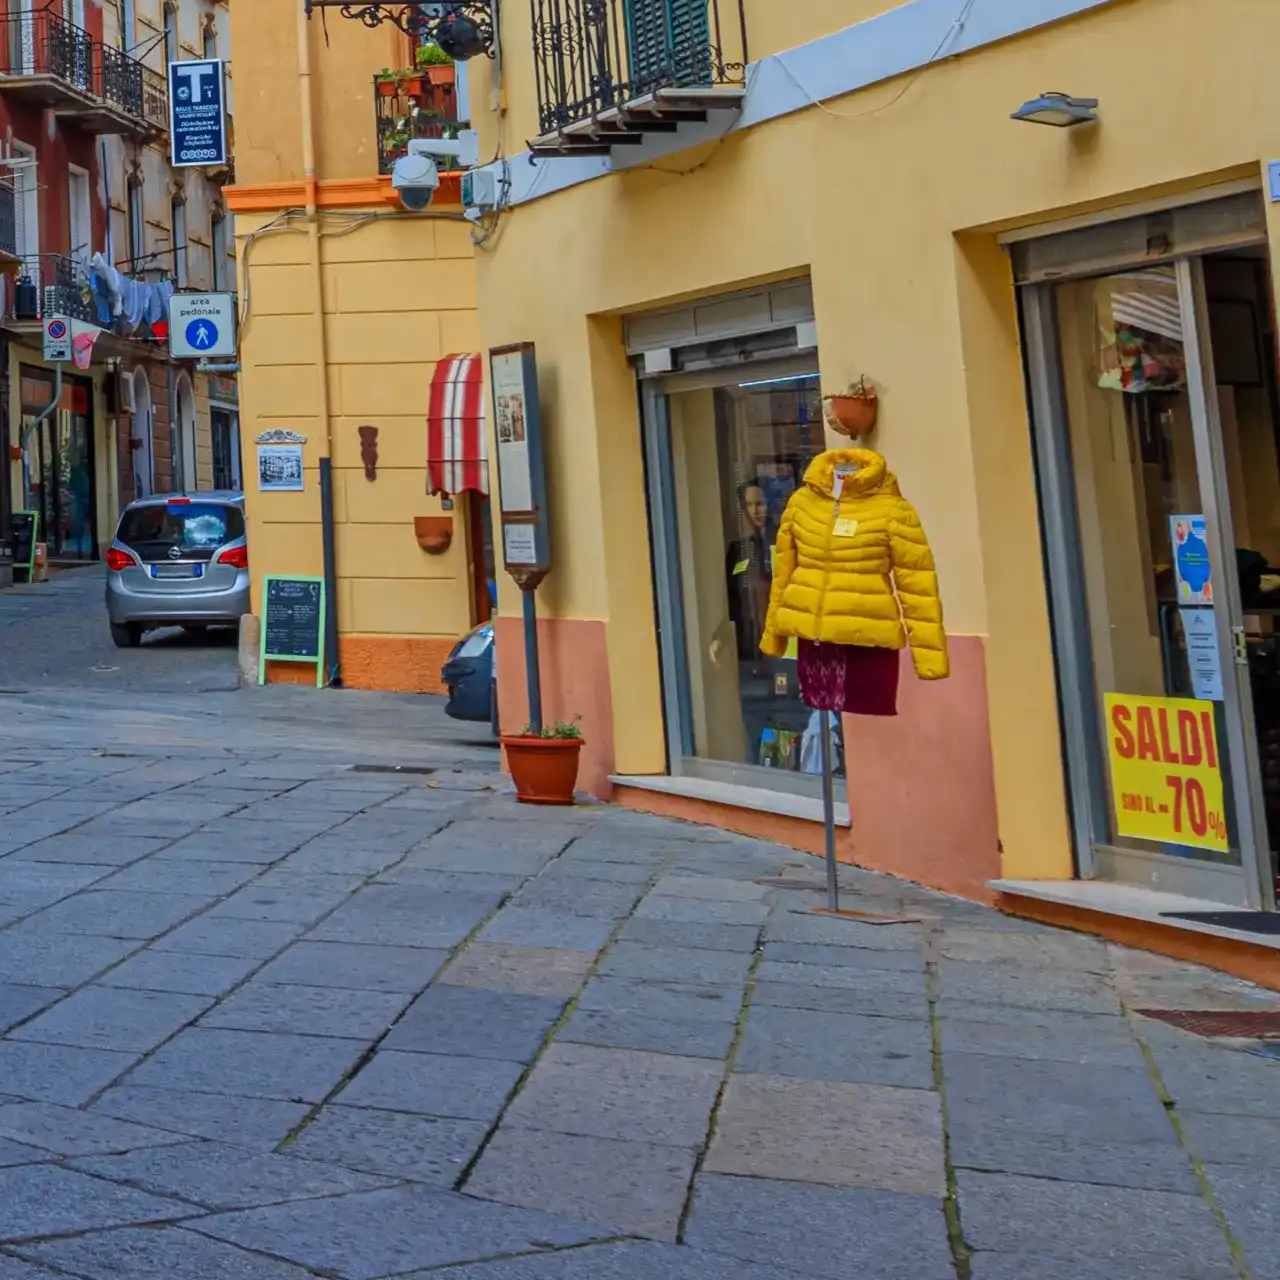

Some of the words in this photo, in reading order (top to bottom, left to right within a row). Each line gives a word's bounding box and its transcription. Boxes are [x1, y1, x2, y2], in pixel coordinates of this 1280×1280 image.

[177, 64, 213, 102] T
[180, 308, 221, 316] pedonale
[1111, 704, 1217, 768] SALDI
[1121, 792, 1143, 812] SINO
[1145, 796, 1156, 814] AL
